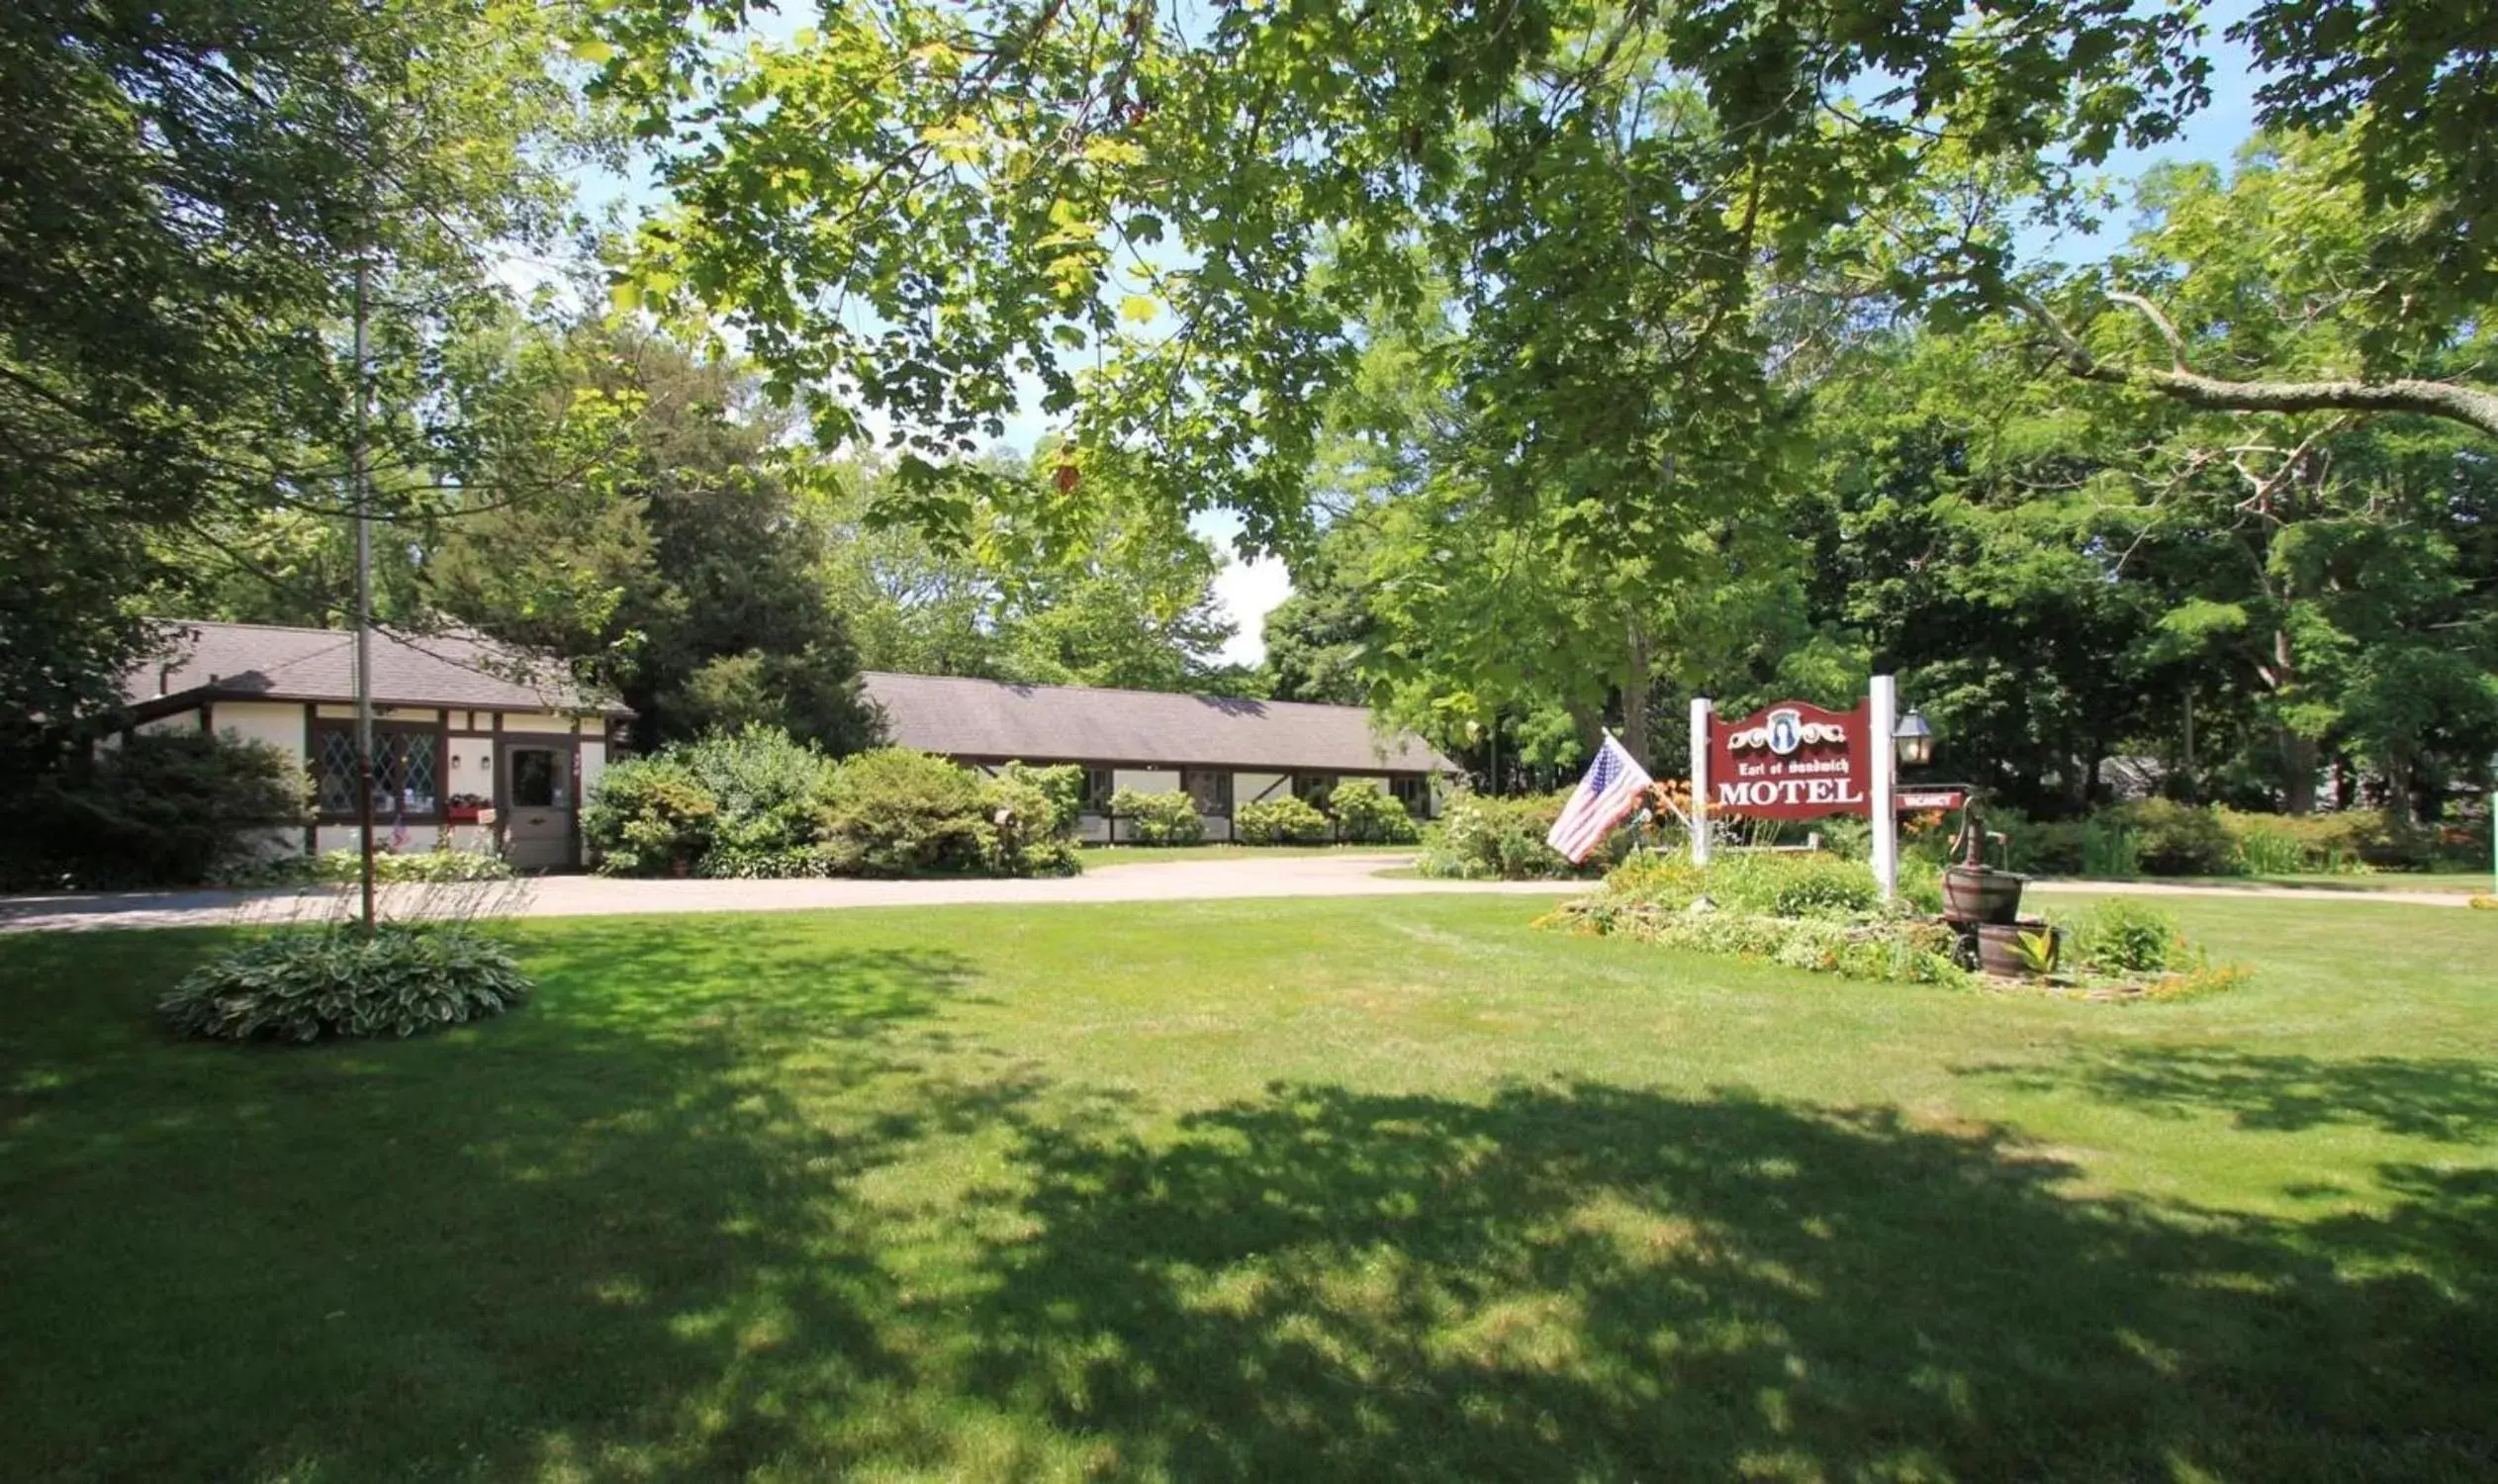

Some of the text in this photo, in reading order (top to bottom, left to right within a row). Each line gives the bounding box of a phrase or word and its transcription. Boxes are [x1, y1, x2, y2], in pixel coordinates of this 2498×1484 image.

[1738, 763, 1765, 776] Earl
[1770, 762, 1782, 775] of
[1718, 779, 1864, 805] MOTEL
